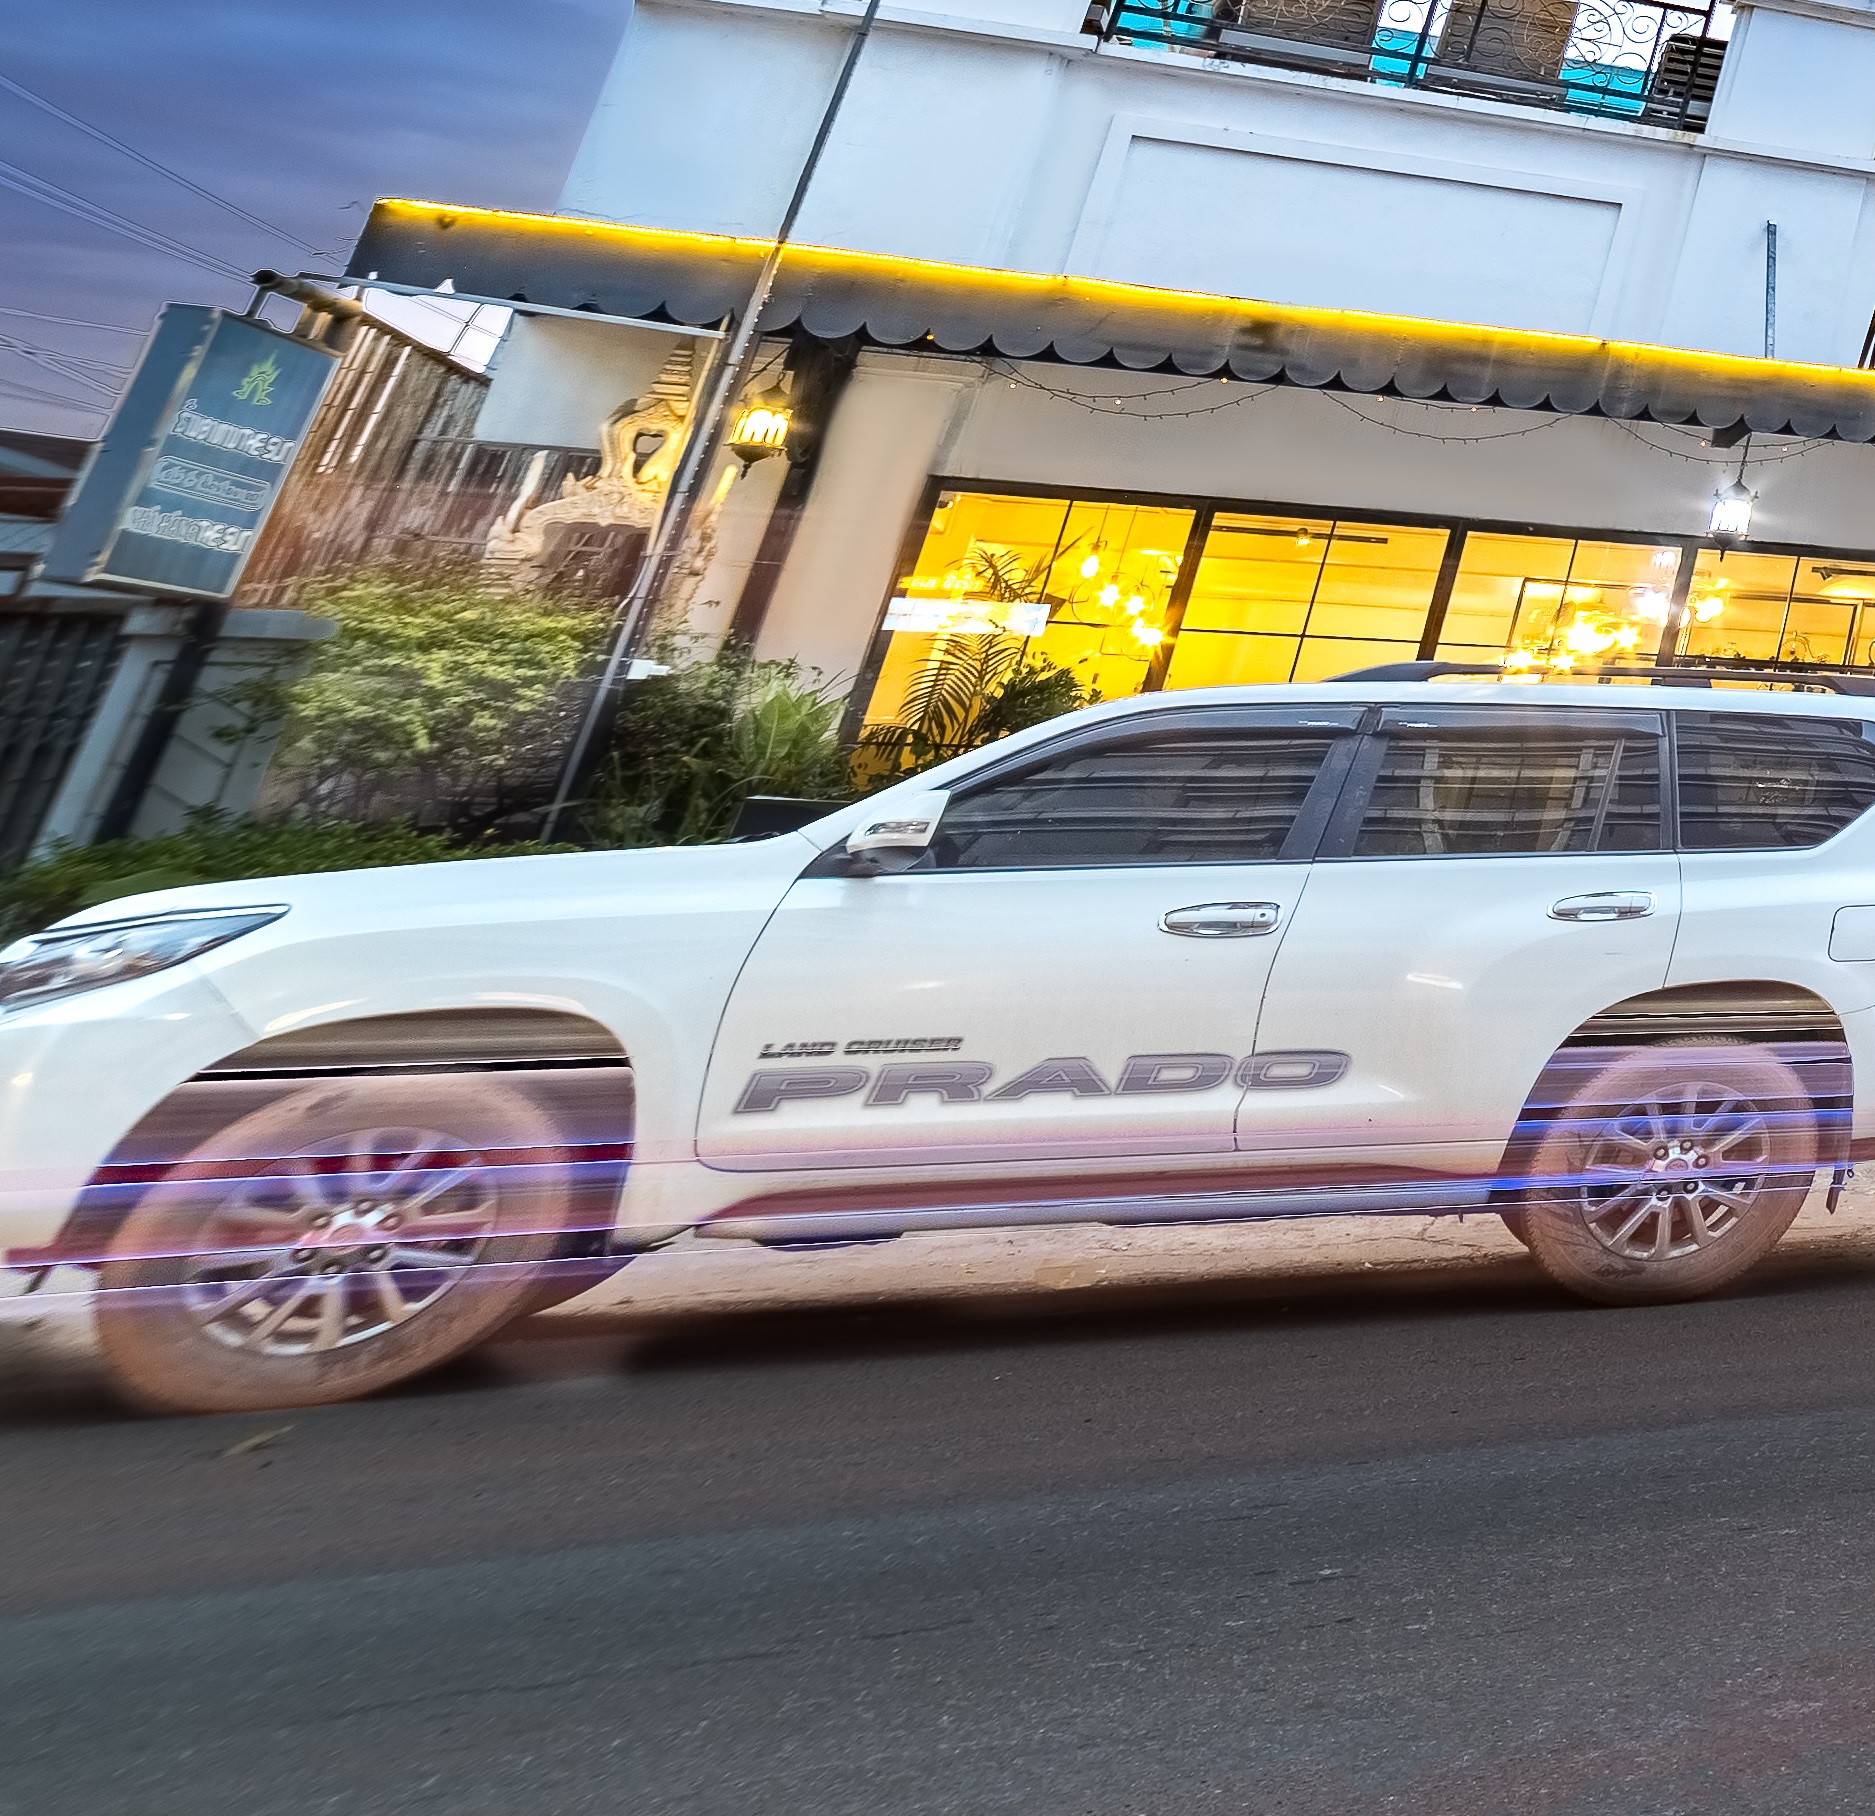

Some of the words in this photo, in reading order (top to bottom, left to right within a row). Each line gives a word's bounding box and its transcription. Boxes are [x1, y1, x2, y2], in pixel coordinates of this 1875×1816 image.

[757, 1041, 838, 1060] LAND
[843, 1036, 965, 1055] CRUISER
[733, 1050, 1354, 1115] PRADO
